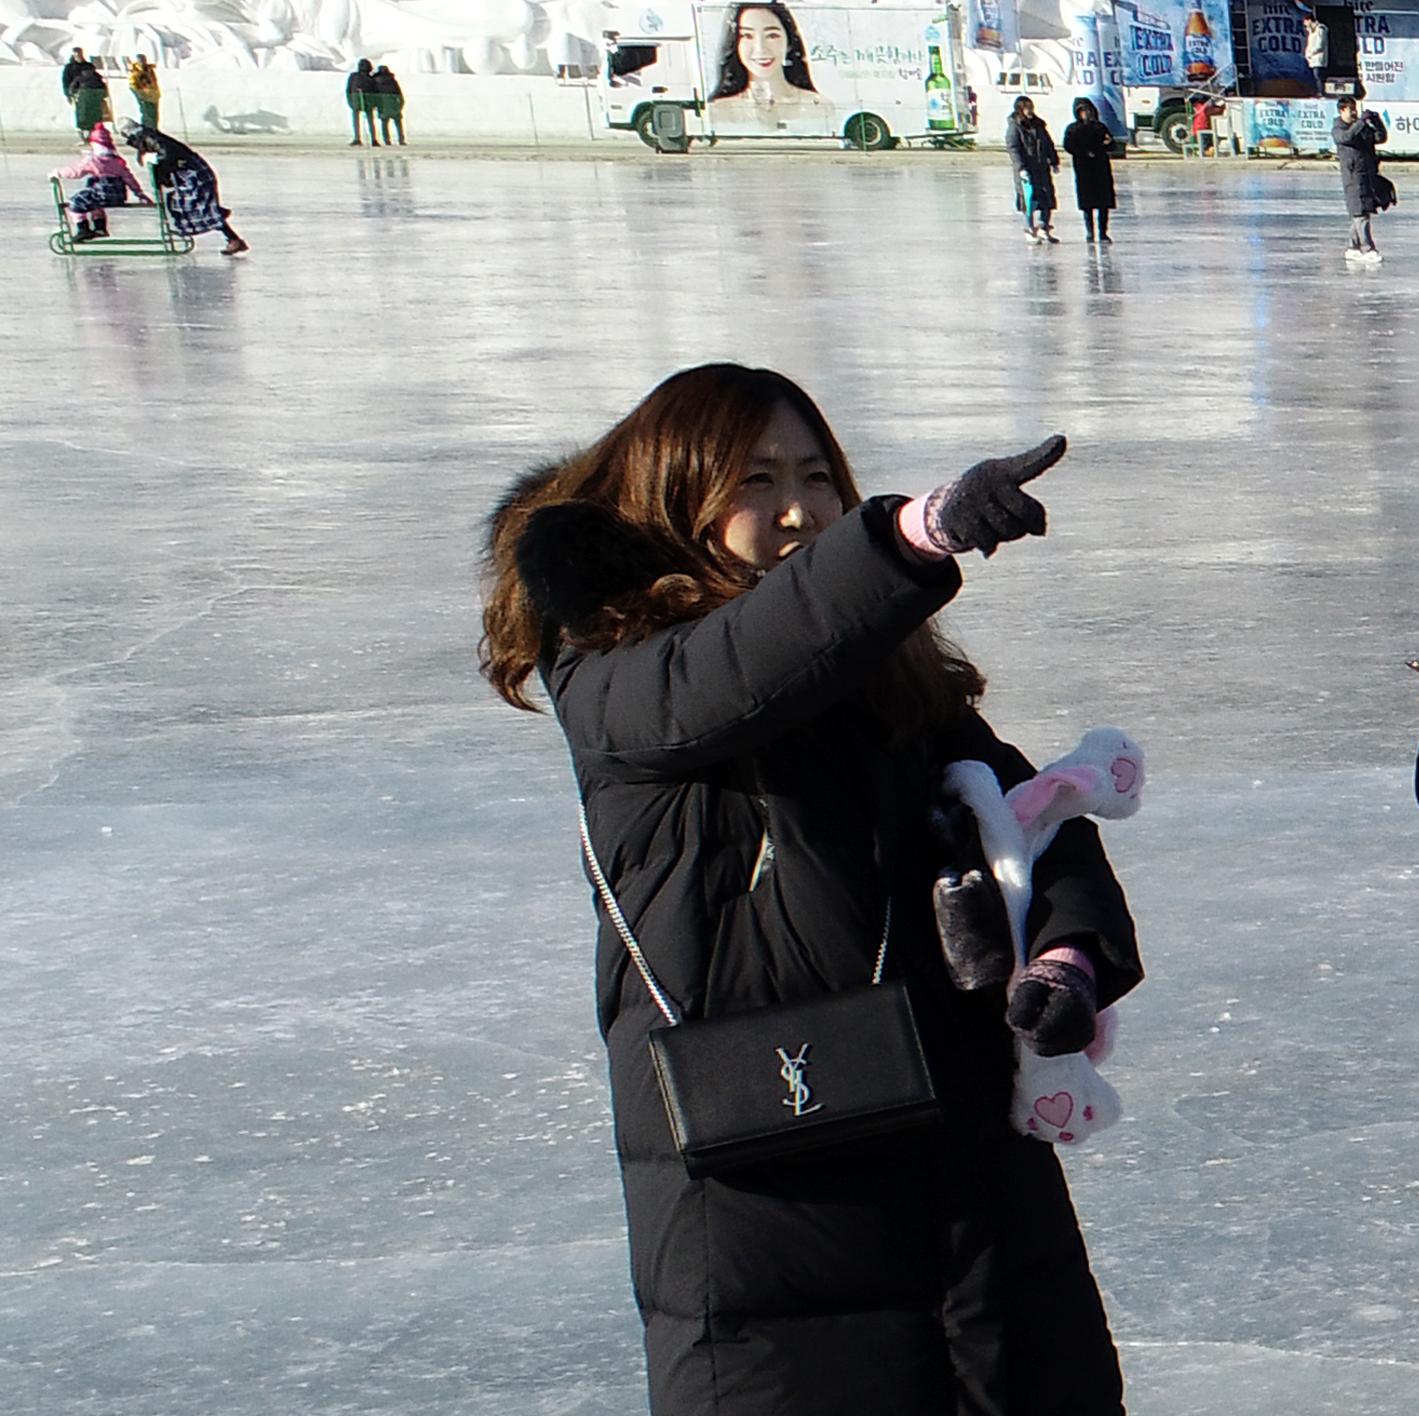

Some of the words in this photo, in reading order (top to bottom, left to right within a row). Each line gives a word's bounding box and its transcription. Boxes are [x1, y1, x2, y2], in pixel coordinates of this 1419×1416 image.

[1252, 16, 1305, 36] EXTRA
[1355, 15, 1391, 34] TRA
[1130, 25, 1174, 52] EXTRA
[1258, 35, 1302, 54] COLD
[1362, 36, 1385, 55] LD
[1140, 54, 1174, 78] COLD
